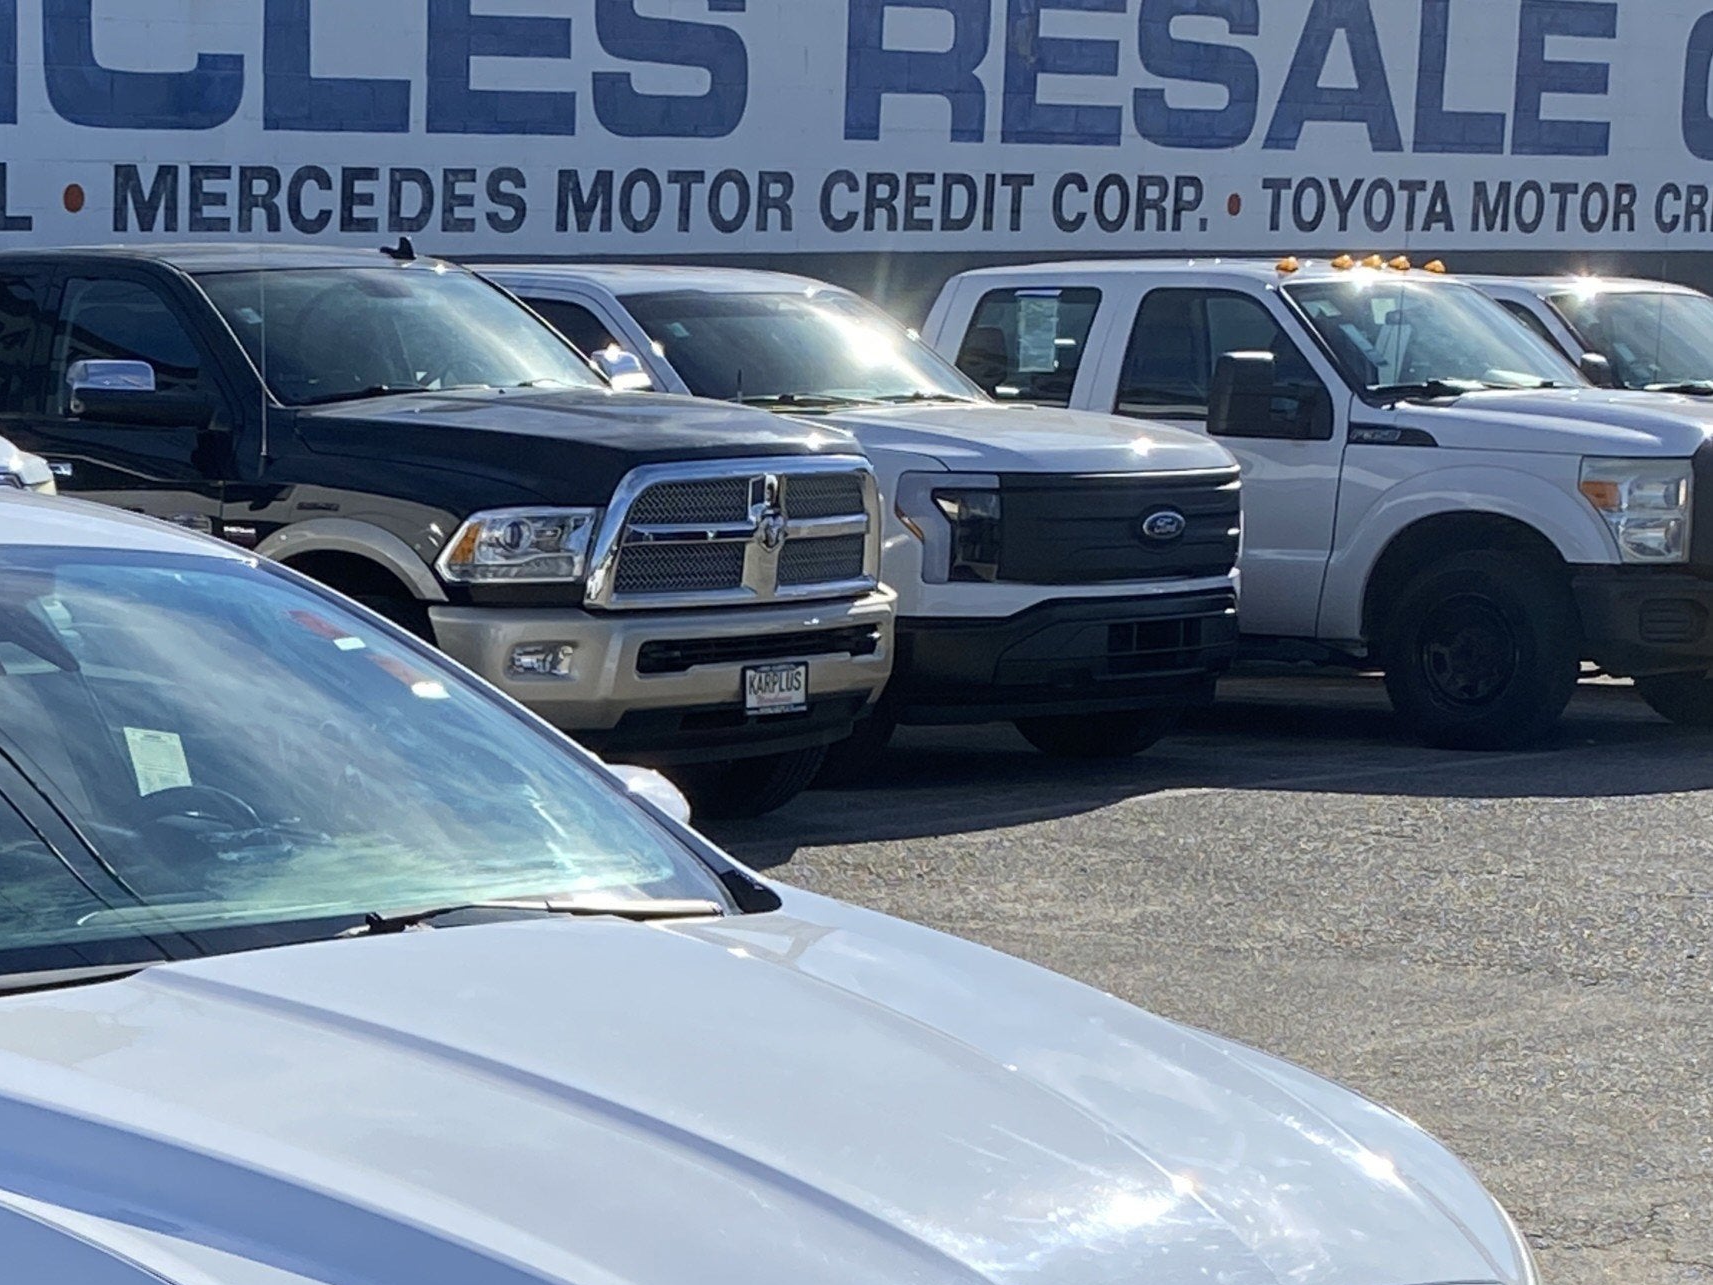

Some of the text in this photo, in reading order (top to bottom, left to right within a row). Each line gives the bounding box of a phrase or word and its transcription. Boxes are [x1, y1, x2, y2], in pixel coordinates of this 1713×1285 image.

[843, 0, 1617, 157] RESALE
[112, 163, 527, 234] MERCEDES
[555, 167, 793, 235] MOTOR
[819, 170, 1035, 234] CREDIT
[1052, 172, 1208, 234] CORP.
[1262, 177, 1455, 233] TOYOTA
[1471, 179, 1636, 234] MOTOR
[1654, 182, 1713, 234] CR
[748, 671, 802, 696] KARPLUS
